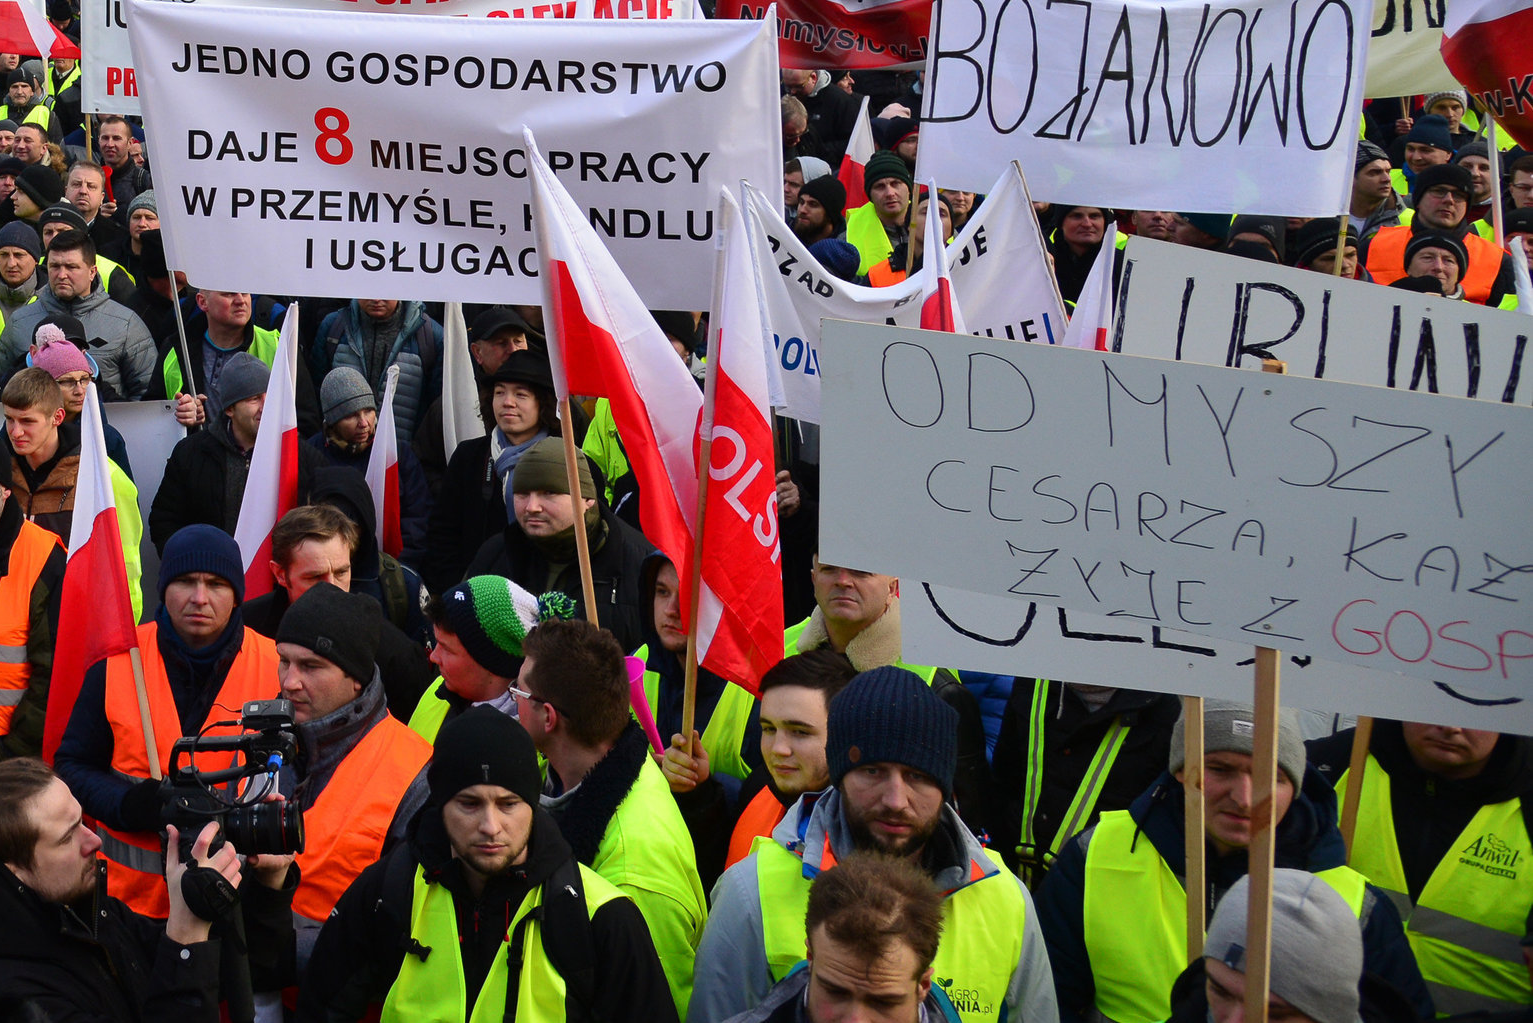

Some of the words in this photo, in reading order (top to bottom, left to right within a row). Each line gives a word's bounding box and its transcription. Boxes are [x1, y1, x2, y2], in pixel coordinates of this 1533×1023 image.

[172, 42, 311, 81] JEDNO
[325, 50, 727, 95] GOSPODARSTWO
[188, 130, 298, 163] DAJE
[314, 107, 354, 165] 8
[370, 139, 528, 179] MIEJSC
[548, 150, 710, 184] PRACY
[181, 185, 217, 217] W
[231, 187, 507, 236] PRZEMYŚLE,
[523, 203, 714, 241] NDLU
[305, 238, 314, 269] I
[882, 341, 1035, 433] OD
[1240, 596, 1305, 642] Z
[1461, 836, 1520, 868] Anwil
[948, 989, 979, 1001] AGRO
[952, 1000, 994, 1014] NIA.pl
